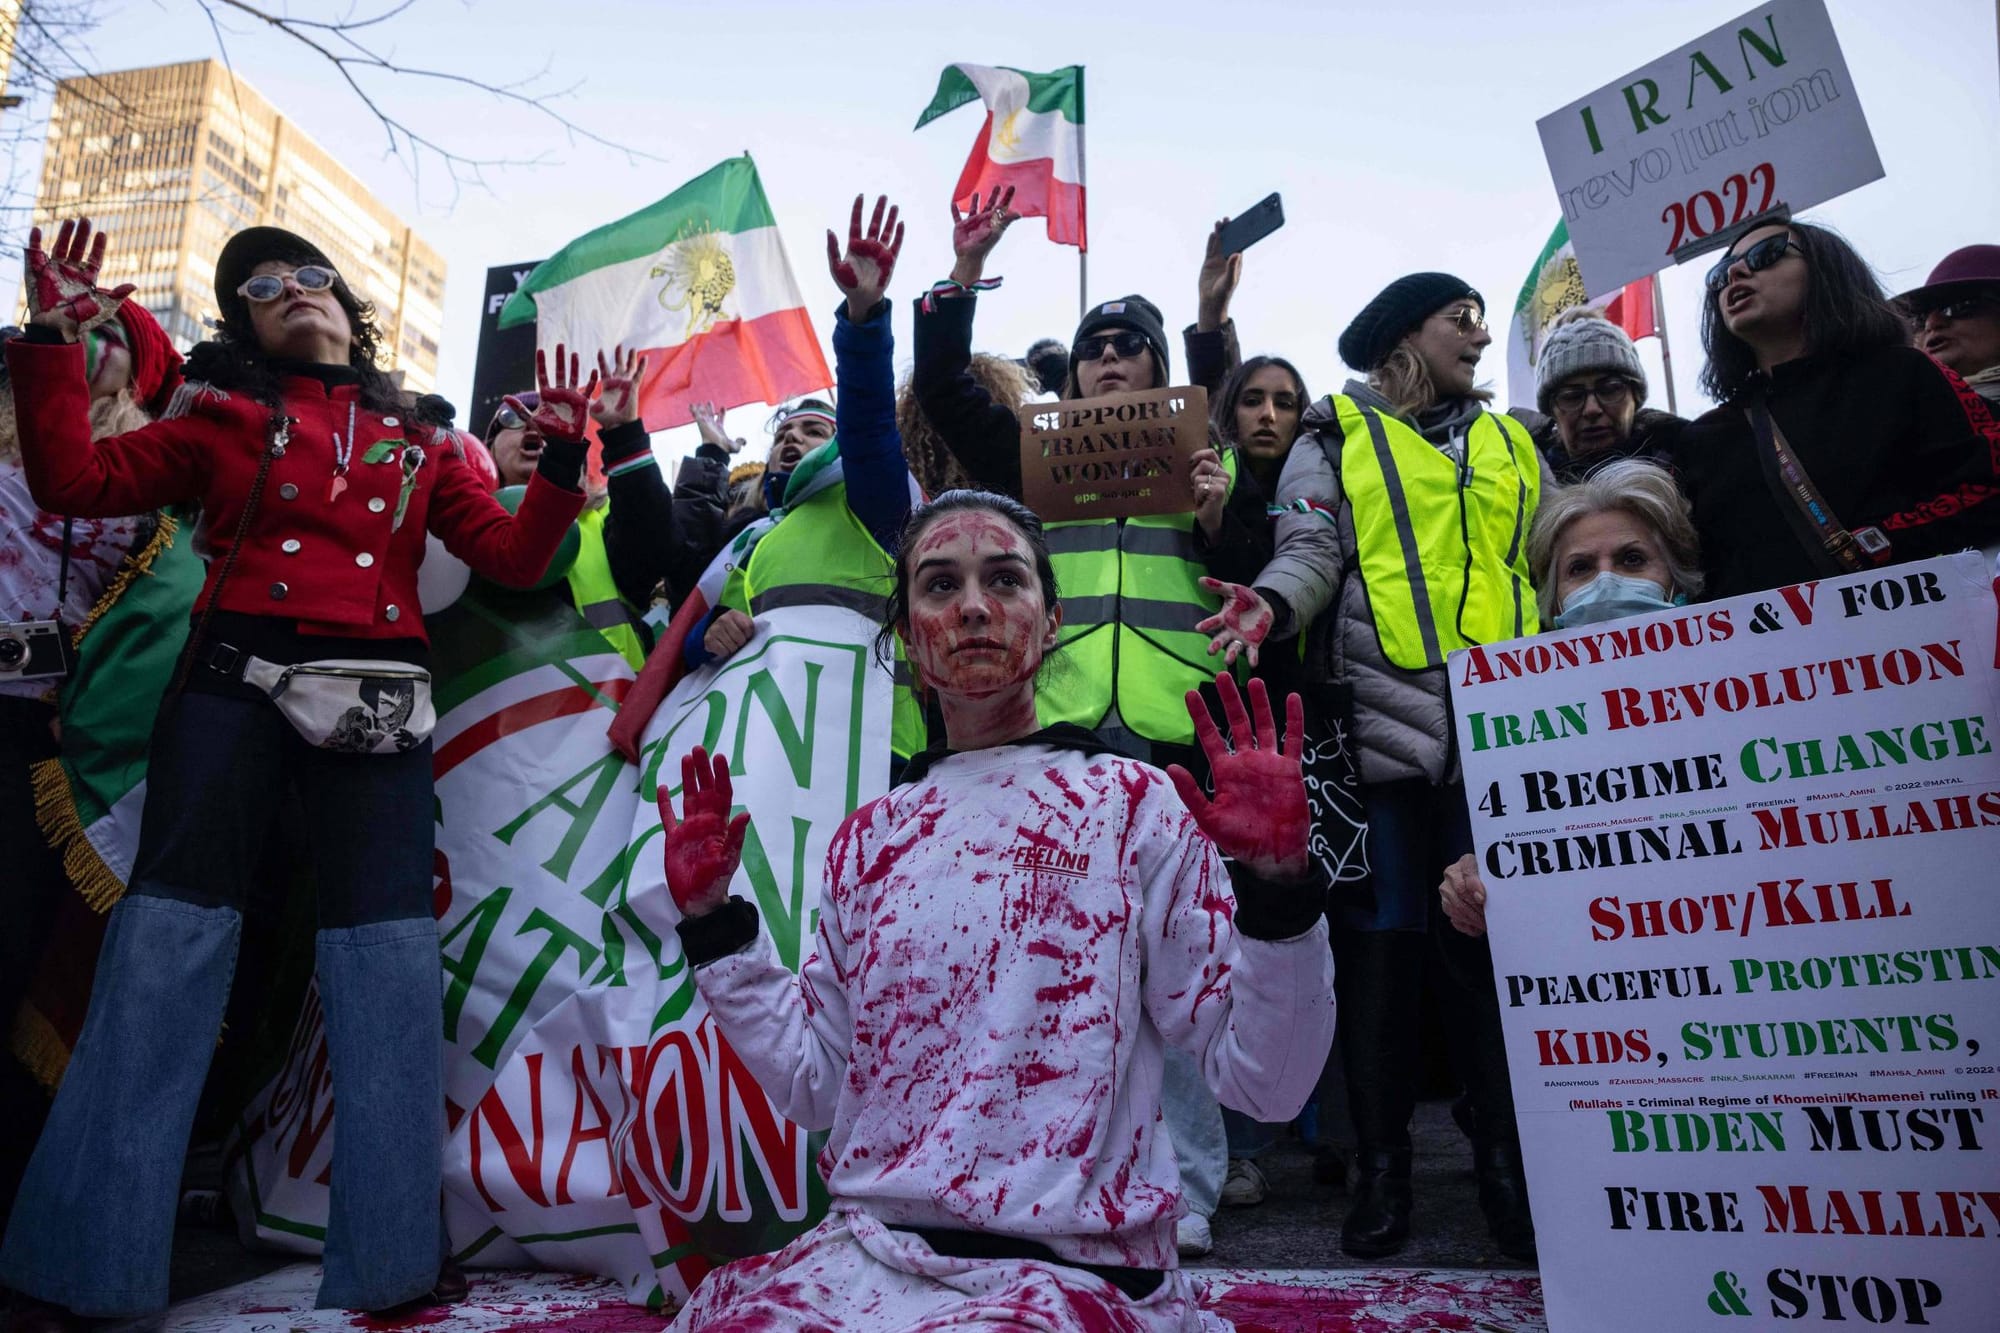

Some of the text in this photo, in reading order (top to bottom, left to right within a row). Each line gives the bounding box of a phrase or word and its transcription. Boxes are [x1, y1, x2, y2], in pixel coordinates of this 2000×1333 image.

[1580, 14, 1787, 155] IRAN
[1560, 67, 1840, 224] revolution
[1661, 163, 1781, 256] 2022
[1033, 398, 1185, 430] SUPPORT
[1040, 427, 1176, 458] IRANIAN
[1050, 457, 1172, 484] WOMEN
[1462, 609, 1734, 687] ANONYMOUS
[1839, 571, 1946, 618] FOR
[1467, 639, 1966, 752] IRAN REVOLUTION
[1478, 716, 1992, 818] 4 REGIME CHANGE
[1895, 780, 1922, 791] 2022
[1486, 792, 2000, 879] CRIMINAL MULLAHS
[1588, 878, 1912, 941] SHOT/KILL
[1507, 966, 1722, 1007] PEACEFUL
[1534, 1013, 1980, 1067] KIDS, STUDENTS,
[1966, 1066, 1994, 1075] 2022
[1569, 1098, 1623, 1111] (Mullahs
[1638, 1097, 1694, 1108] Criminal
[1698, 1096, 1751, 1108] Regime
[1756, 1095, 1769, 1105] of
[1773, 1091, 1925, 1105] Khomeini/Khamenei
[1930, 1090, 1976, 1103] ruling
[1607, 1106, 1984, 1153] BIDEN MUST
[1604, 1187, 1745, 1233] FIRE
[1707, 1269, 1943, 1326] & STOP
